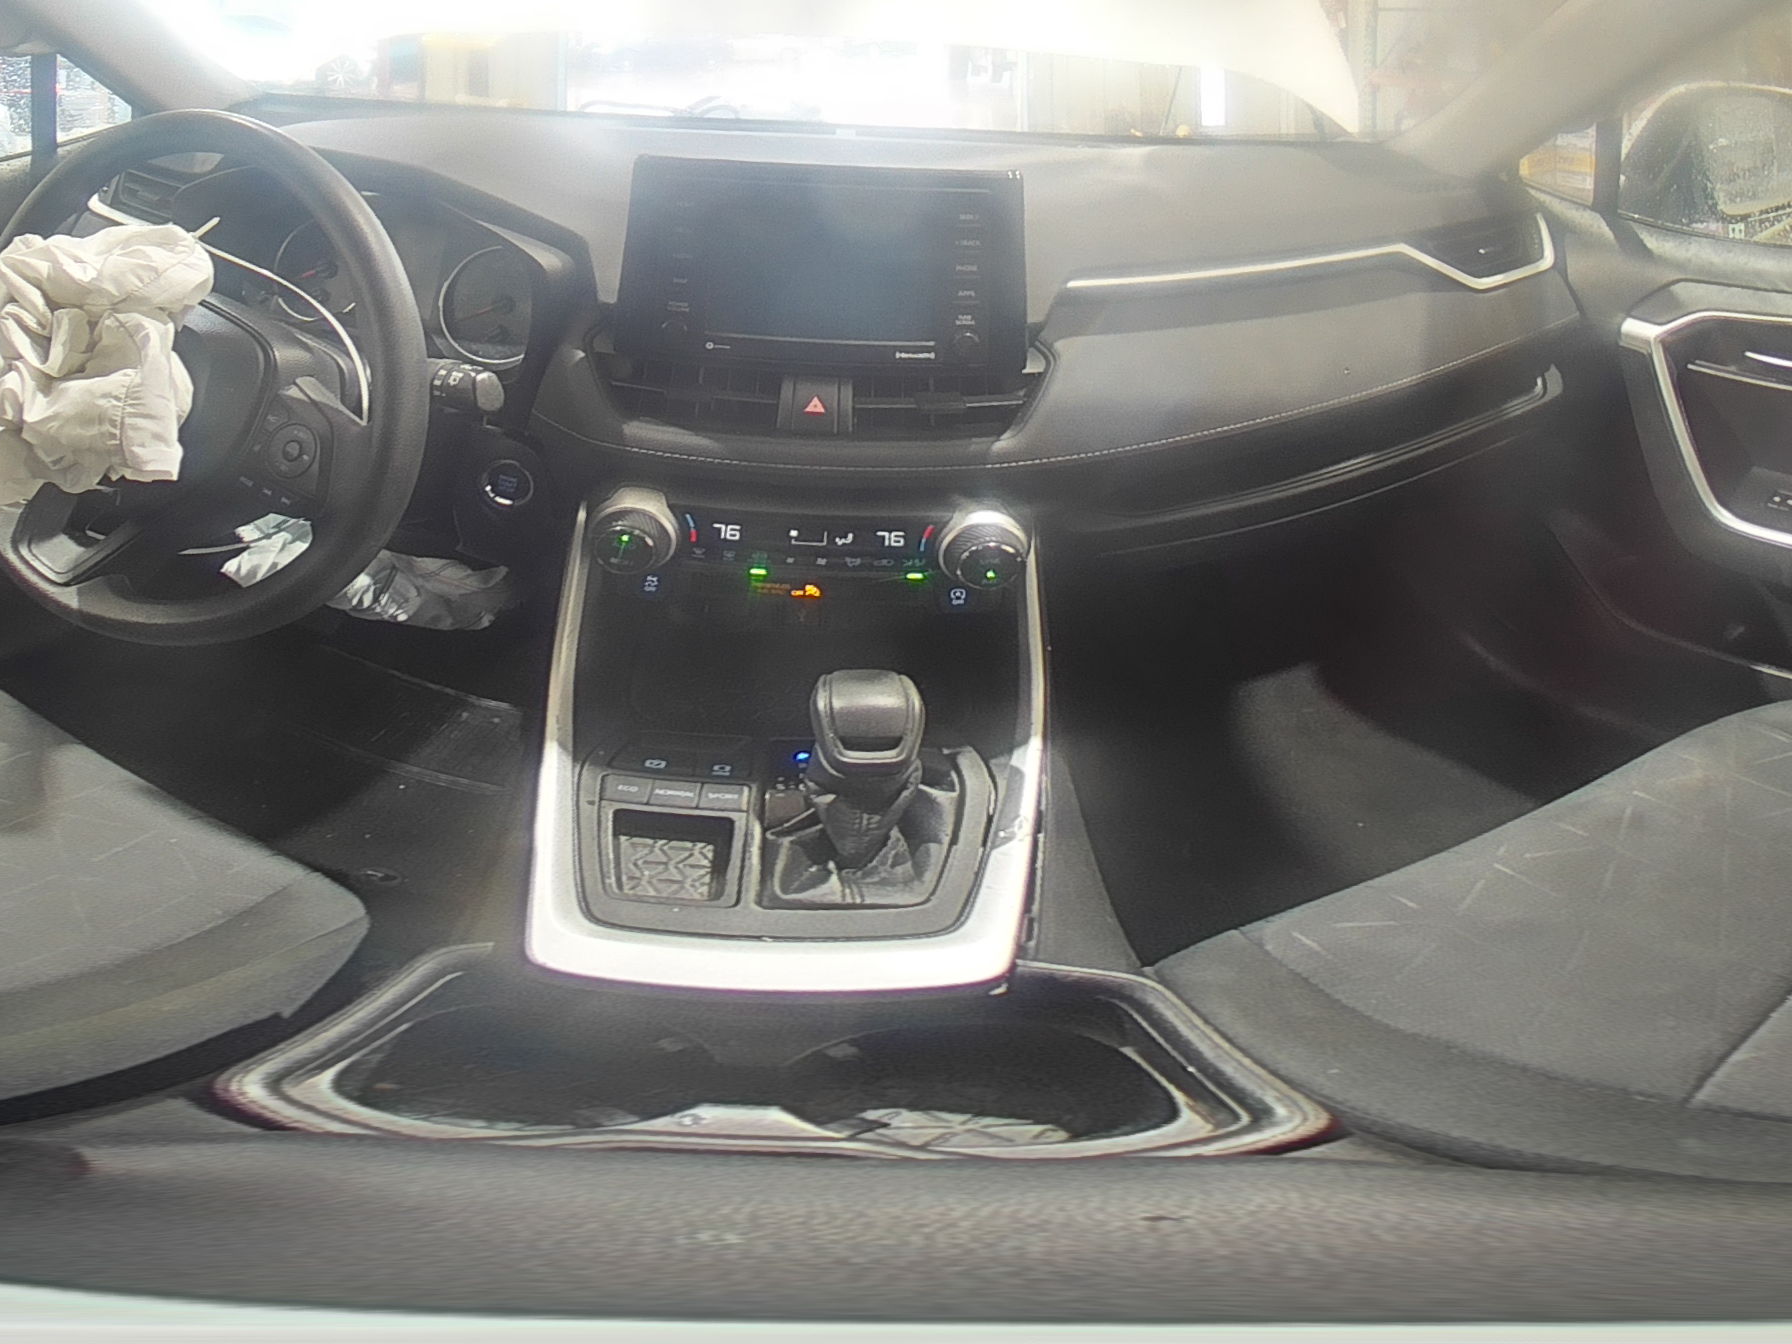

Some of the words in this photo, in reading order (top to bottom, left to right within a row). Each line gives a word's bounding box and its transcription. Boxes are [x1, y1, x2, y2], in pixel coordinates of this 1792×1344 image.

[712, 523, 741, 541] 76
[876, 531, 905, 547] 76
[617, 784, 639, 793] ECO
